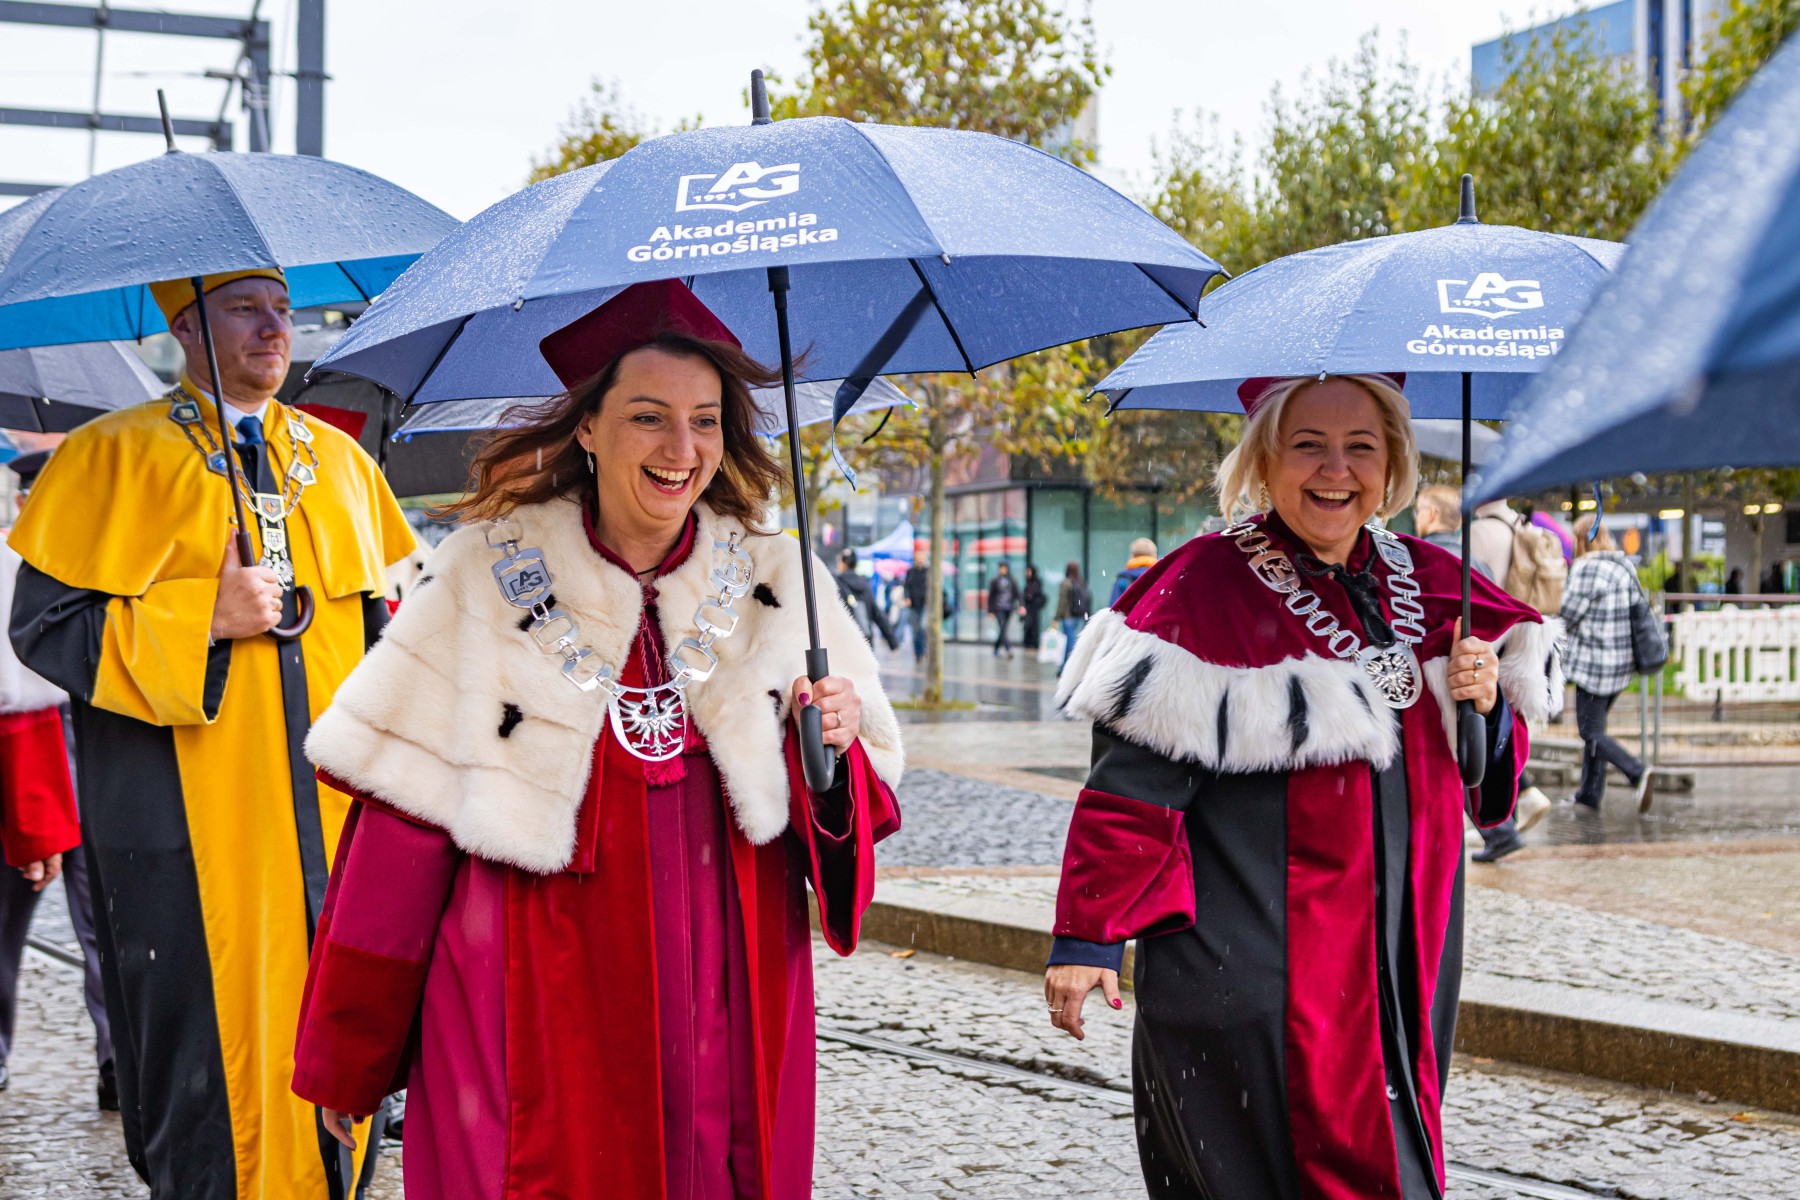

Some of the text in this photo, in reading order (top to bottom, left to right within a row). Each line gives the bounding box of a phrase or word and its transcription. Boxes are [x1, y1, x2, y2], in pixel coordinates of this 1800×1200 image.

[708, 161, 801, 198] AG
[692, 191, 737, 203] 1991
[648, 211, 818, 243] Akademia
[627, 227, 839, 263] Górnośląska
[1464, 272, 1545, 310] AG
[1422, 324, 1566, 340] Akademia
[1406, 339, 1564, 360] Górnośląsk
[519, 570, 544, 587] AG
